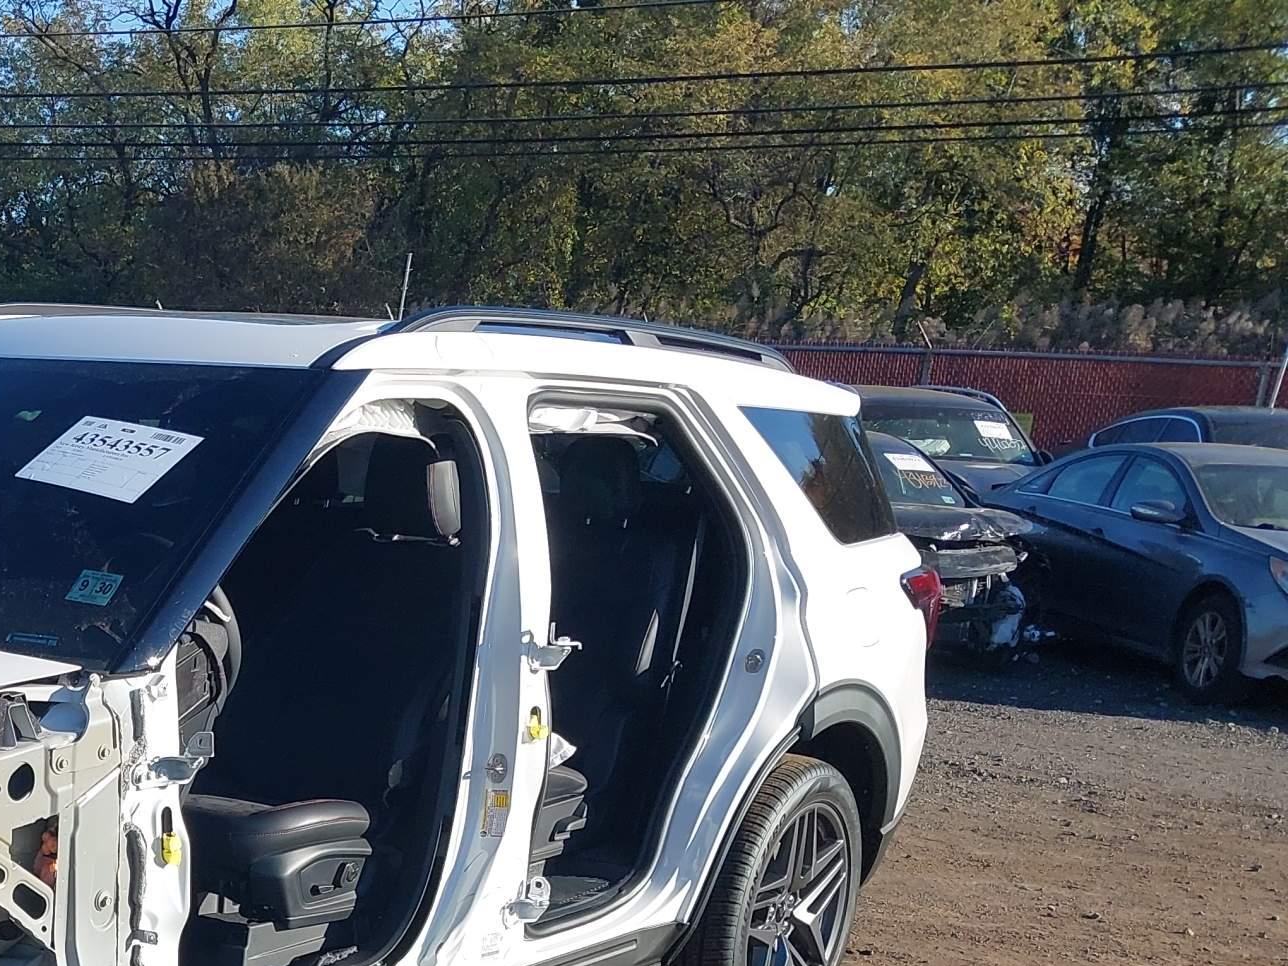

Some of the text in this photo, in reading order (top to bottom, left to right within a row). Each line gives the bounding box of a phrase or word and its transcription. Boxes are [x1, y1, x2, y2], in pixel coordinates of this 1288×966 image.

[73, 431, 173, 460] 43543557
[78, 579, 113, 595] 9 30
